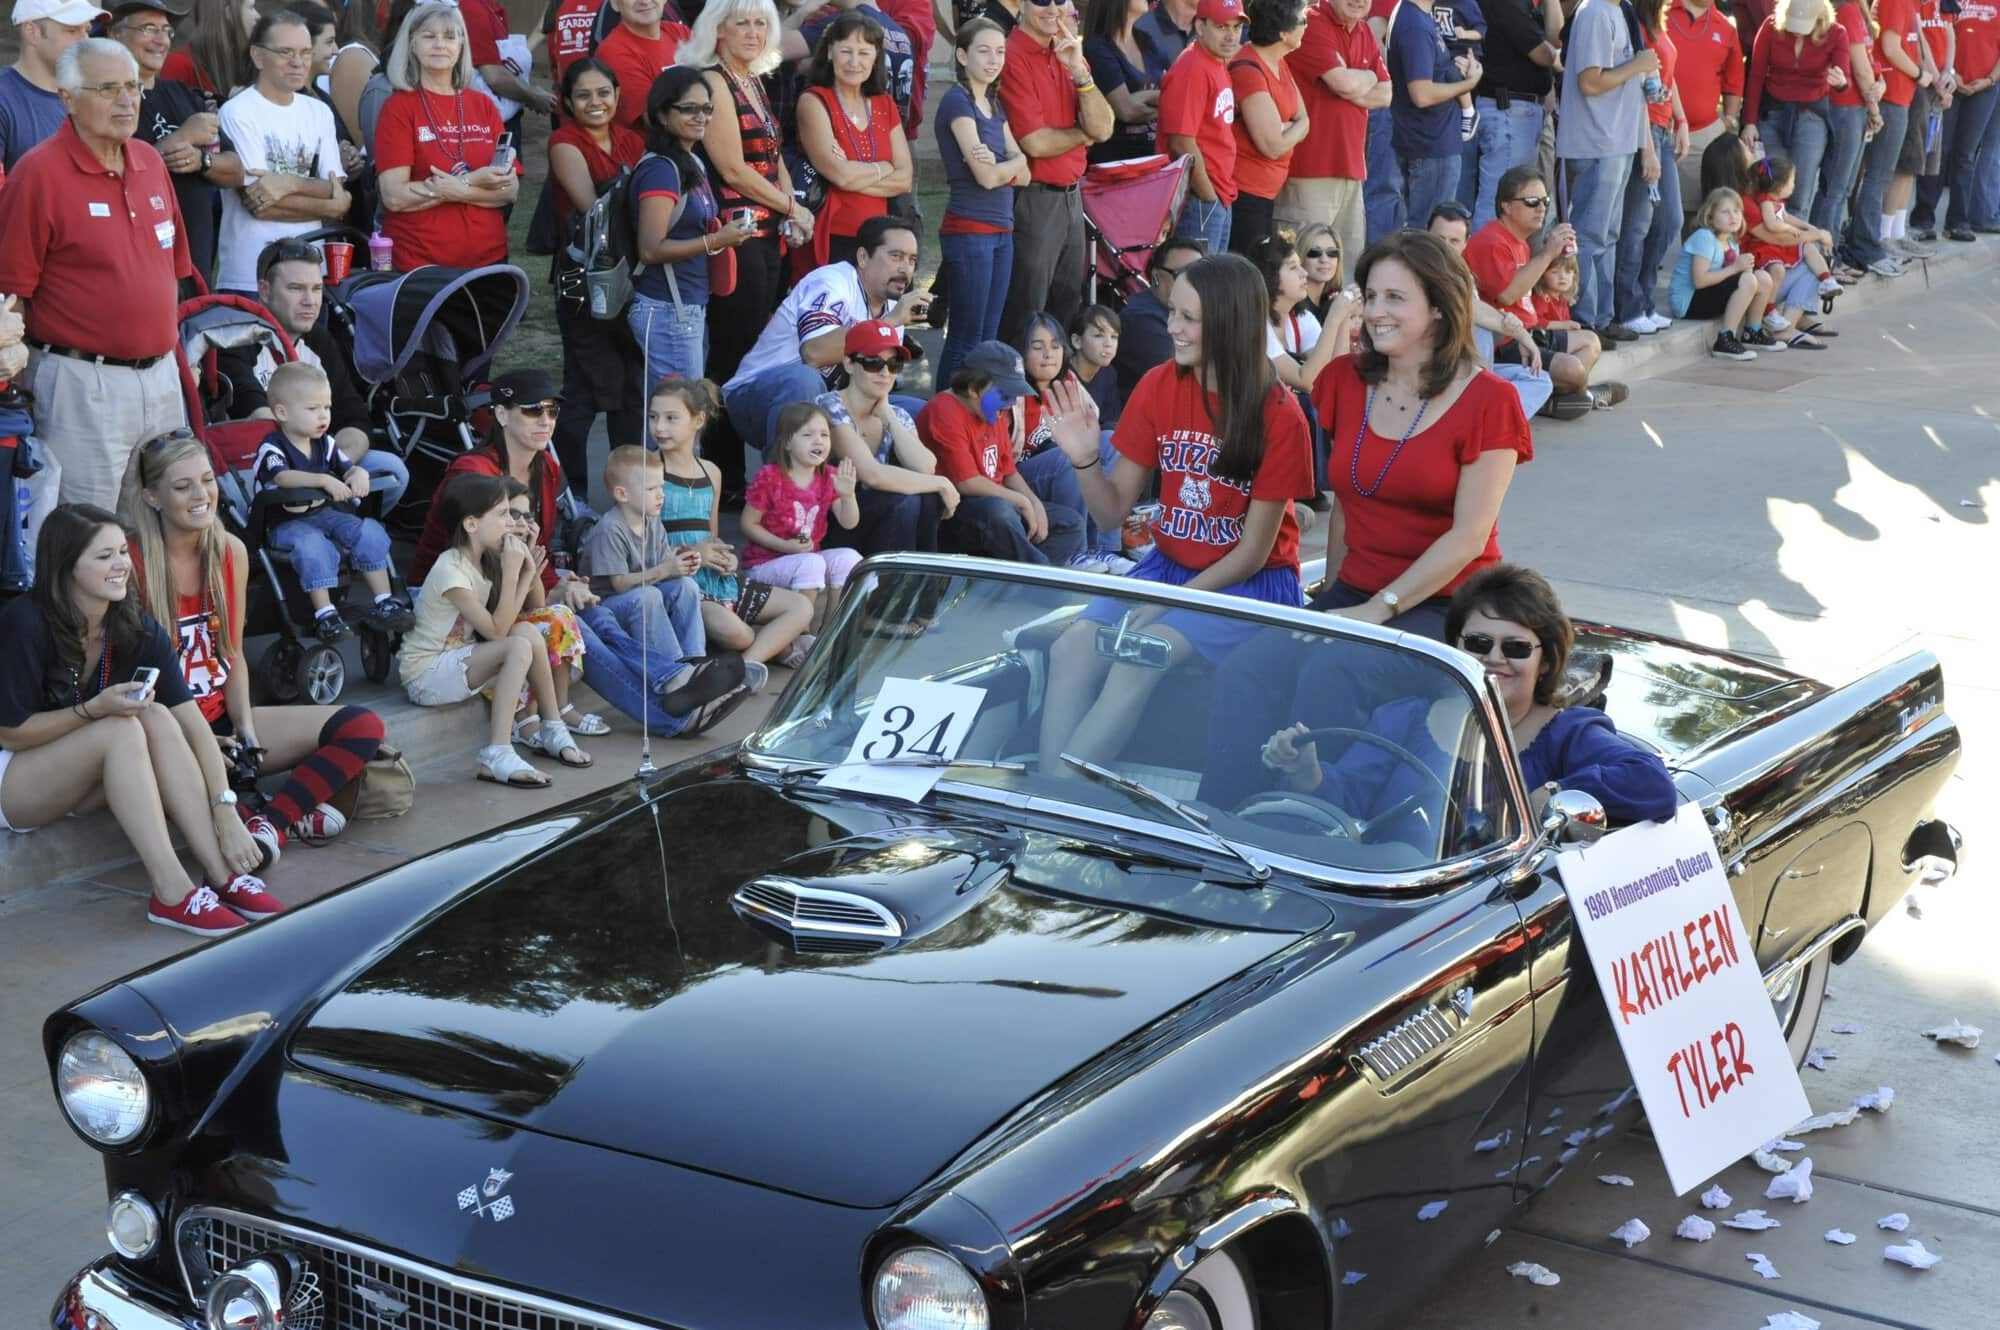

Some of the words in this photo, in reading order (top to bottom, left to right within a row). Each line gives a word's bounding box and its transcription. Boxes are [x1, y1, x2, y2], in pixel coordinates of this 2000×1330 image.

[811, 292, 845, 318] 44
[878, 326, 892, 337] W
[863, 705, 956, 762] 34
[1584, 890, 1613, 921] 1980
[1609, 866, 1680, 910] Homecoming
[1675, 851, 1713, 882] Queen
[1611, 904, 1739, 1024] KATHLEEN
[1667, 1022, 1754, 1118] TYLER
